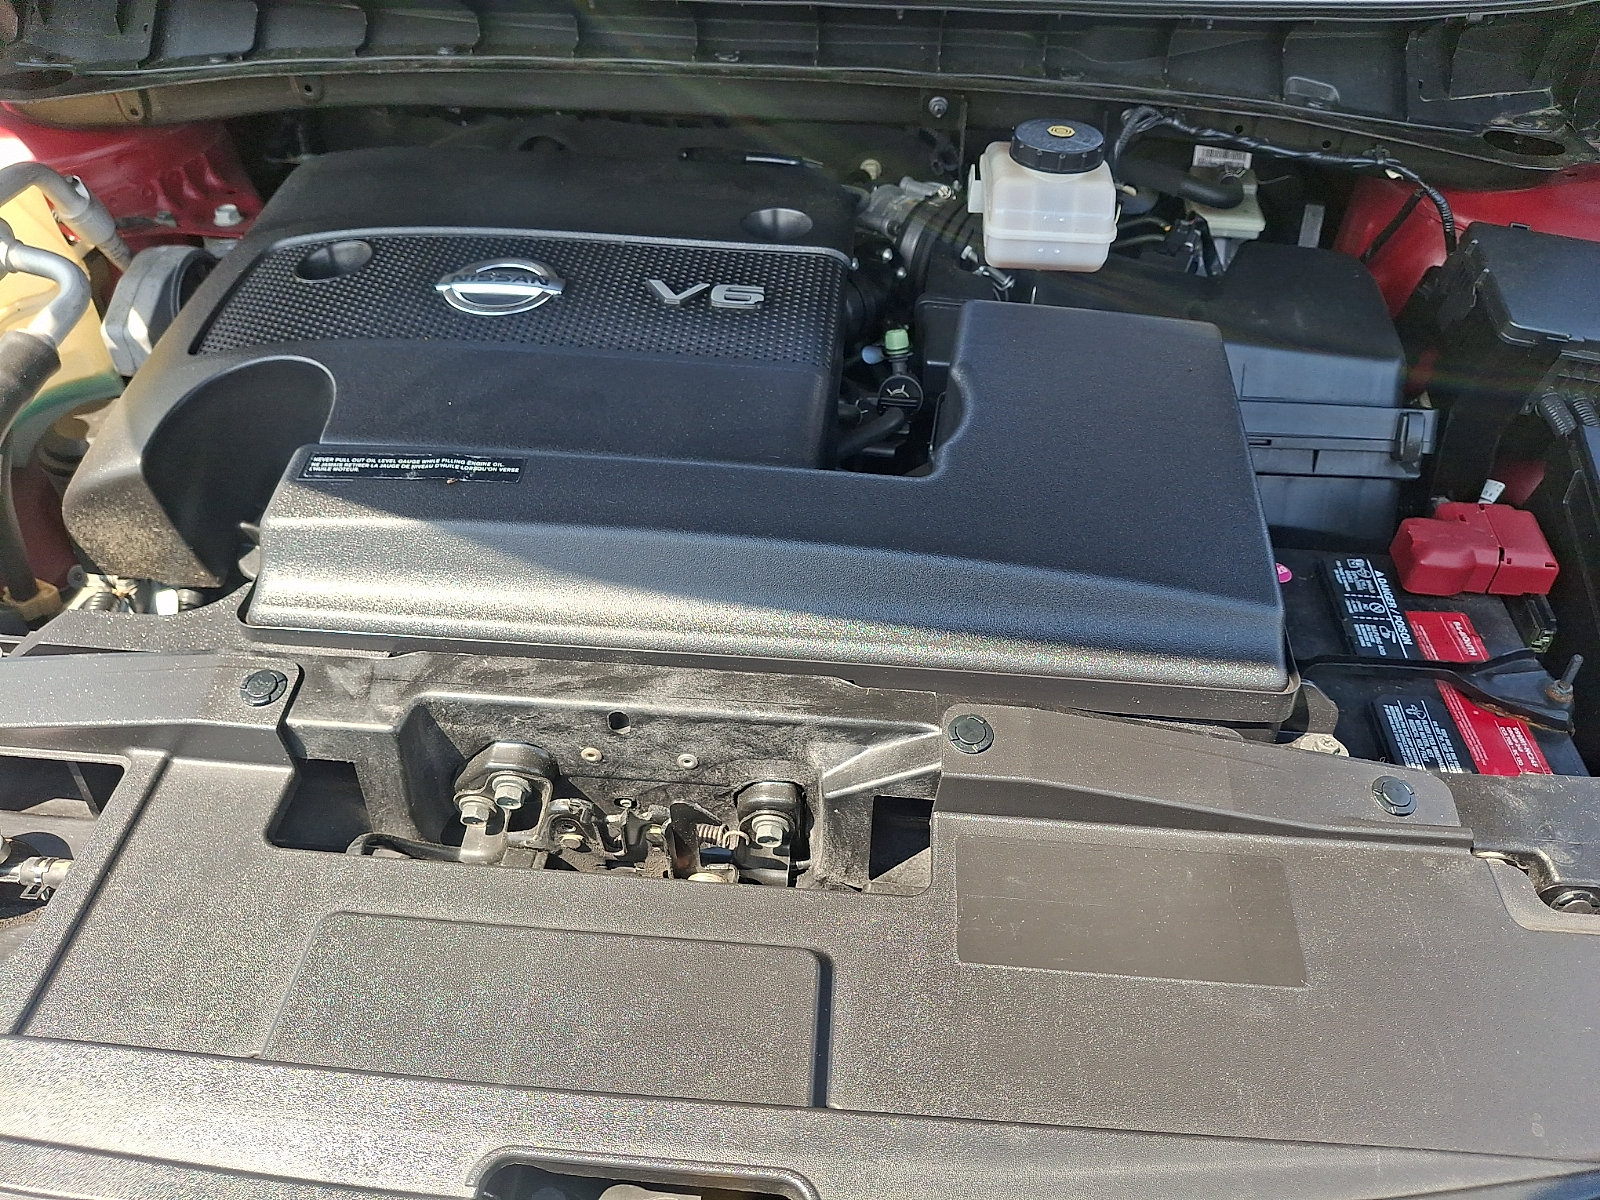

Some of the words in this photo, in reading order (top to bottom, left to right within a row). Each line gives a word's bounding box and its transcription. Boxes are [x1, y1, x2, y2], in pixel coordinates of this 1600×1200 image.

[451, 272, 550, 286] NISSAN
[647, 279, 766, 310] V6
[1377, 577, 1398, 609] DANGER
[1392, 614, 1414, 646] POISON
